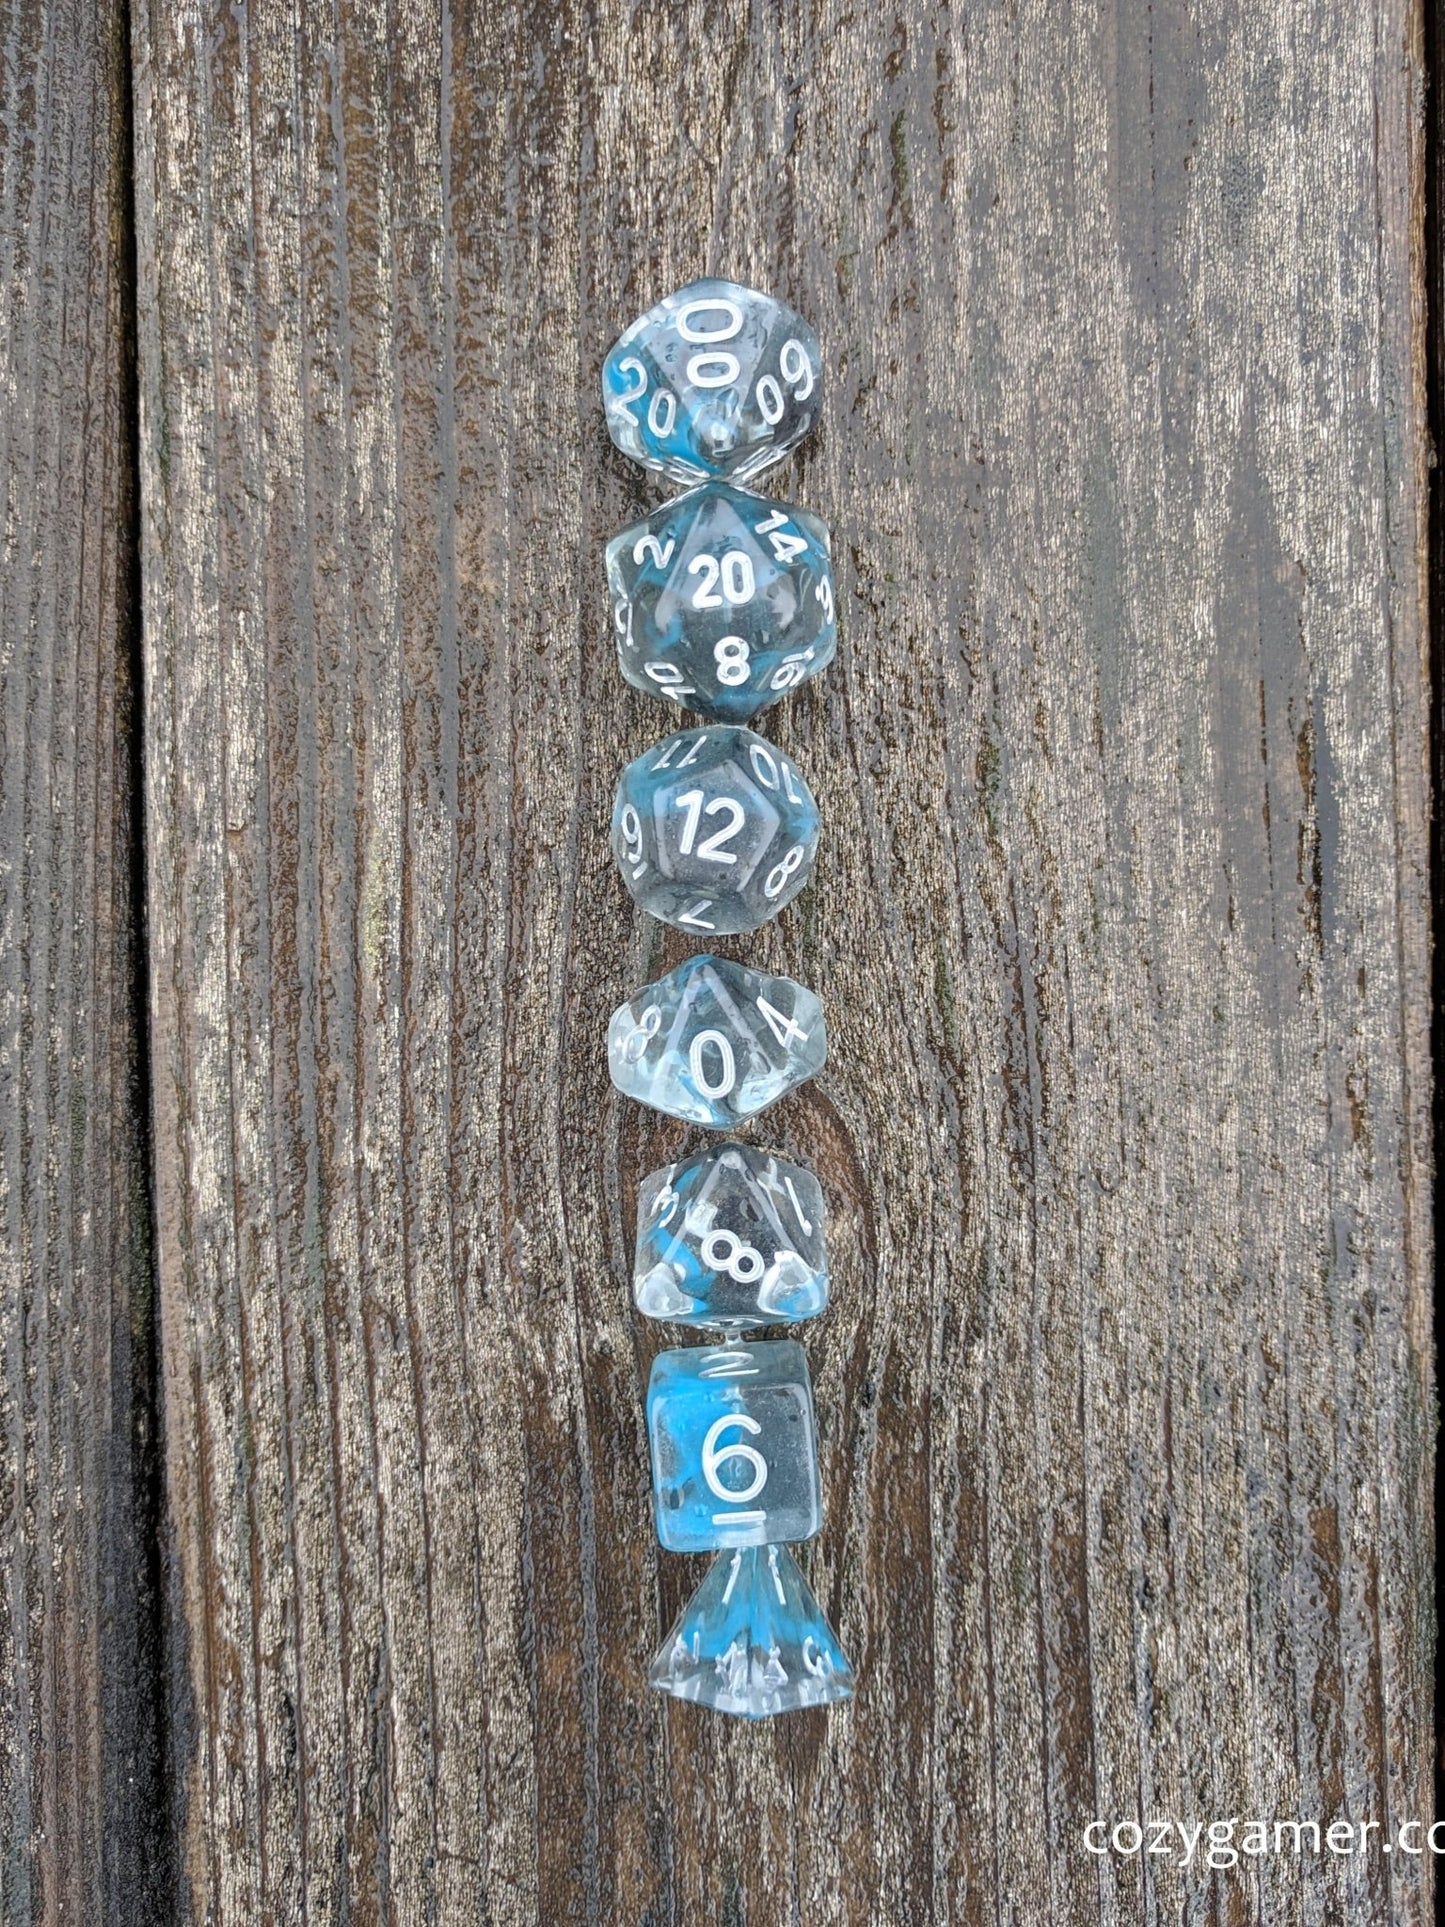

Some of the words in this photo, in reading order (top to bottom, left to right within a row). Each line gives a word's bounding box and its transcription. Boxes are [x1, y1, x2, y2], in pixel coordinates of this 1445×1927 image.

[633, 534, 676, 570] 2
[754, 508, 809, 565] 14
[687, 550, 757, 610] 20
[643, 660, 697, 701] 10
[713, 635, 751, 687] 8
[749, 743, 804, 806] 10
[675, 788, 746, 865] 12
[764, 845, 805, 898] 8
[622, 1003, 662, 1065] 8
[756, 995, 809, 1049] 4
[688, 1028, 736, 1100] 0
[700, 1228, 766, 1284] 8
[698, 1351, 761, 1378] 2
[701, 1413, 768, 1503] 6
